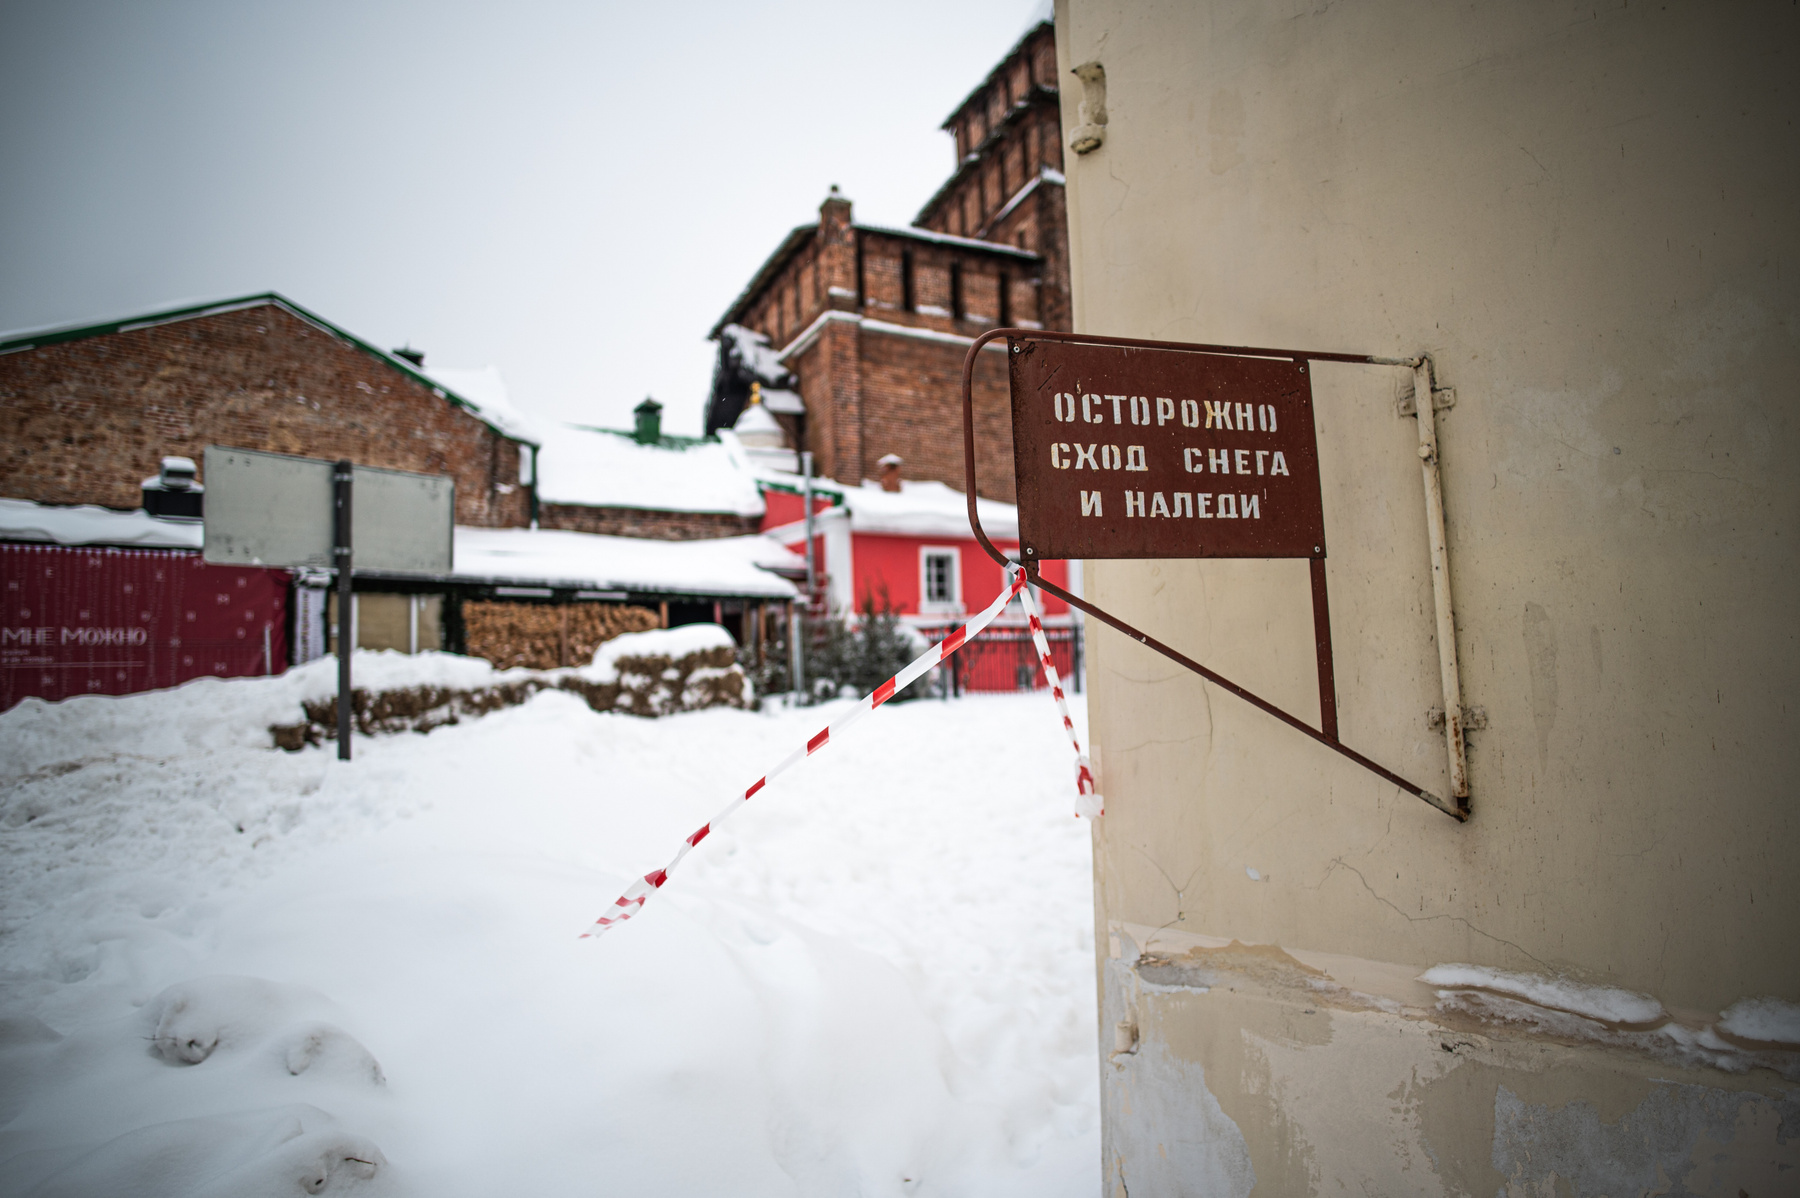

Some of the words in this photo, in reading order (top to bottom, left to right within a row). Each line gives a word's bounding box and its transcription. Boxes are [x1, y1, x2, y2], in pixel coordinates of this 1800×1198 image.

[1053, 392, 1278, 433] ОСТОРОЖНО
[1050, 442, 1148, 472] СХОД
[1183, 447, 1290, 477] СНЕГА
[1080, 490, 1103, 518] И
[1125, 489, 1261, 519] НАЛЕДИ
[1, 626, 56, 646] МНЕ
[60, 626, 148, 646] МОЖНО
